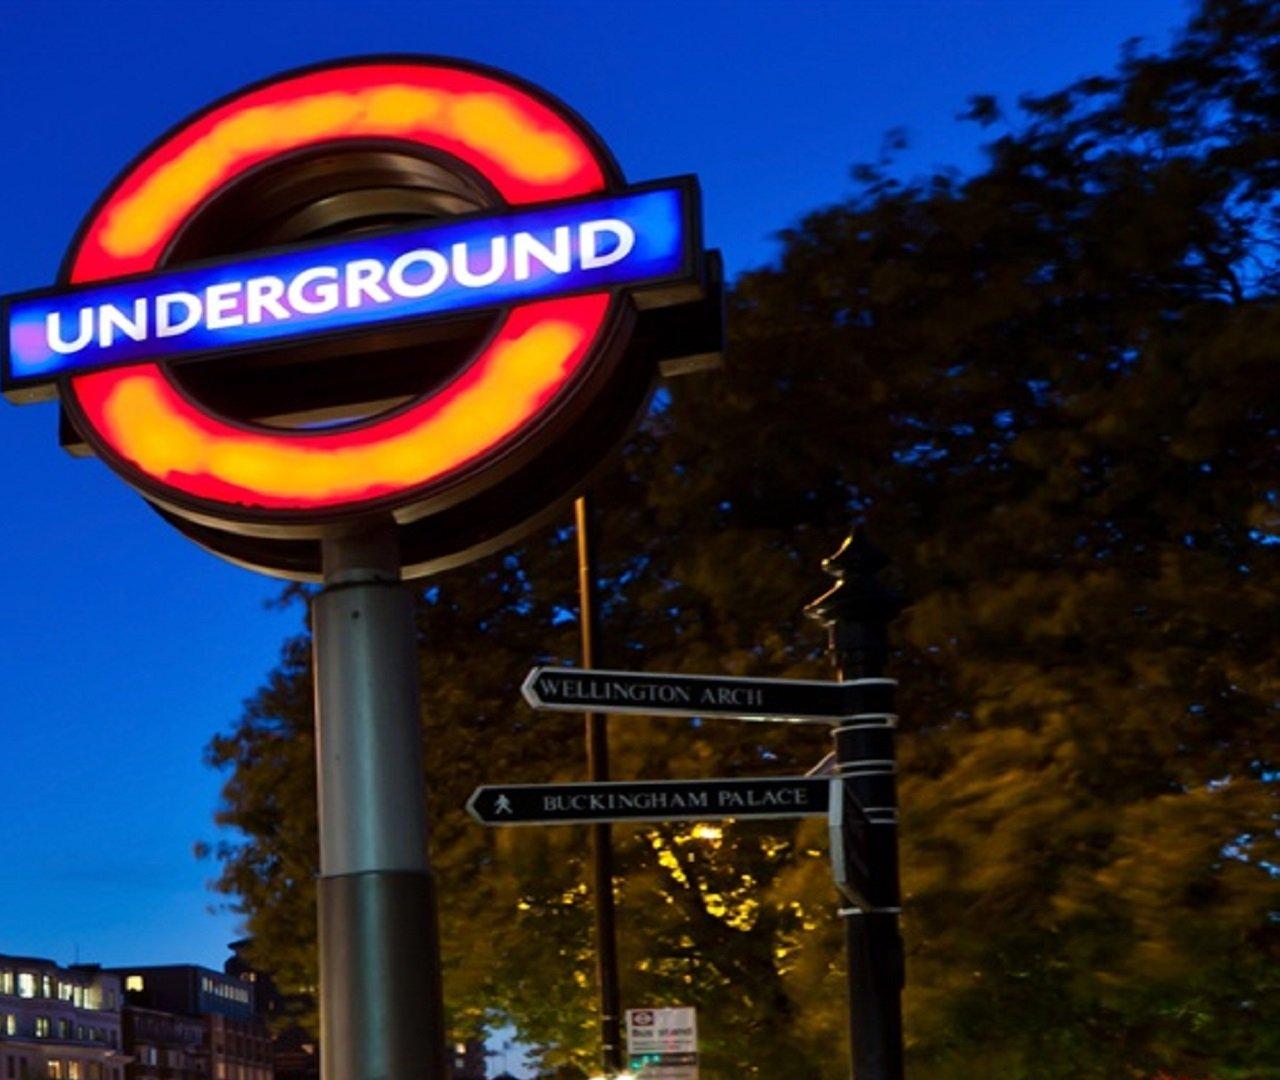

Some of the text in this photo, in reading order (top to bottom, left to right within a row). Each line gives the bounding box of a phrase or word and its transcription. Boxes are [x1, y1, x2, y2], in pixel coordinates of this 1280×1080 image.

[45, 217, 636, 355] UNDERGROUND
[540, 678, 764, 706] WELLINGTON ARCH
[543, 787, 808, 812] BUCKINGHAM PALACE
